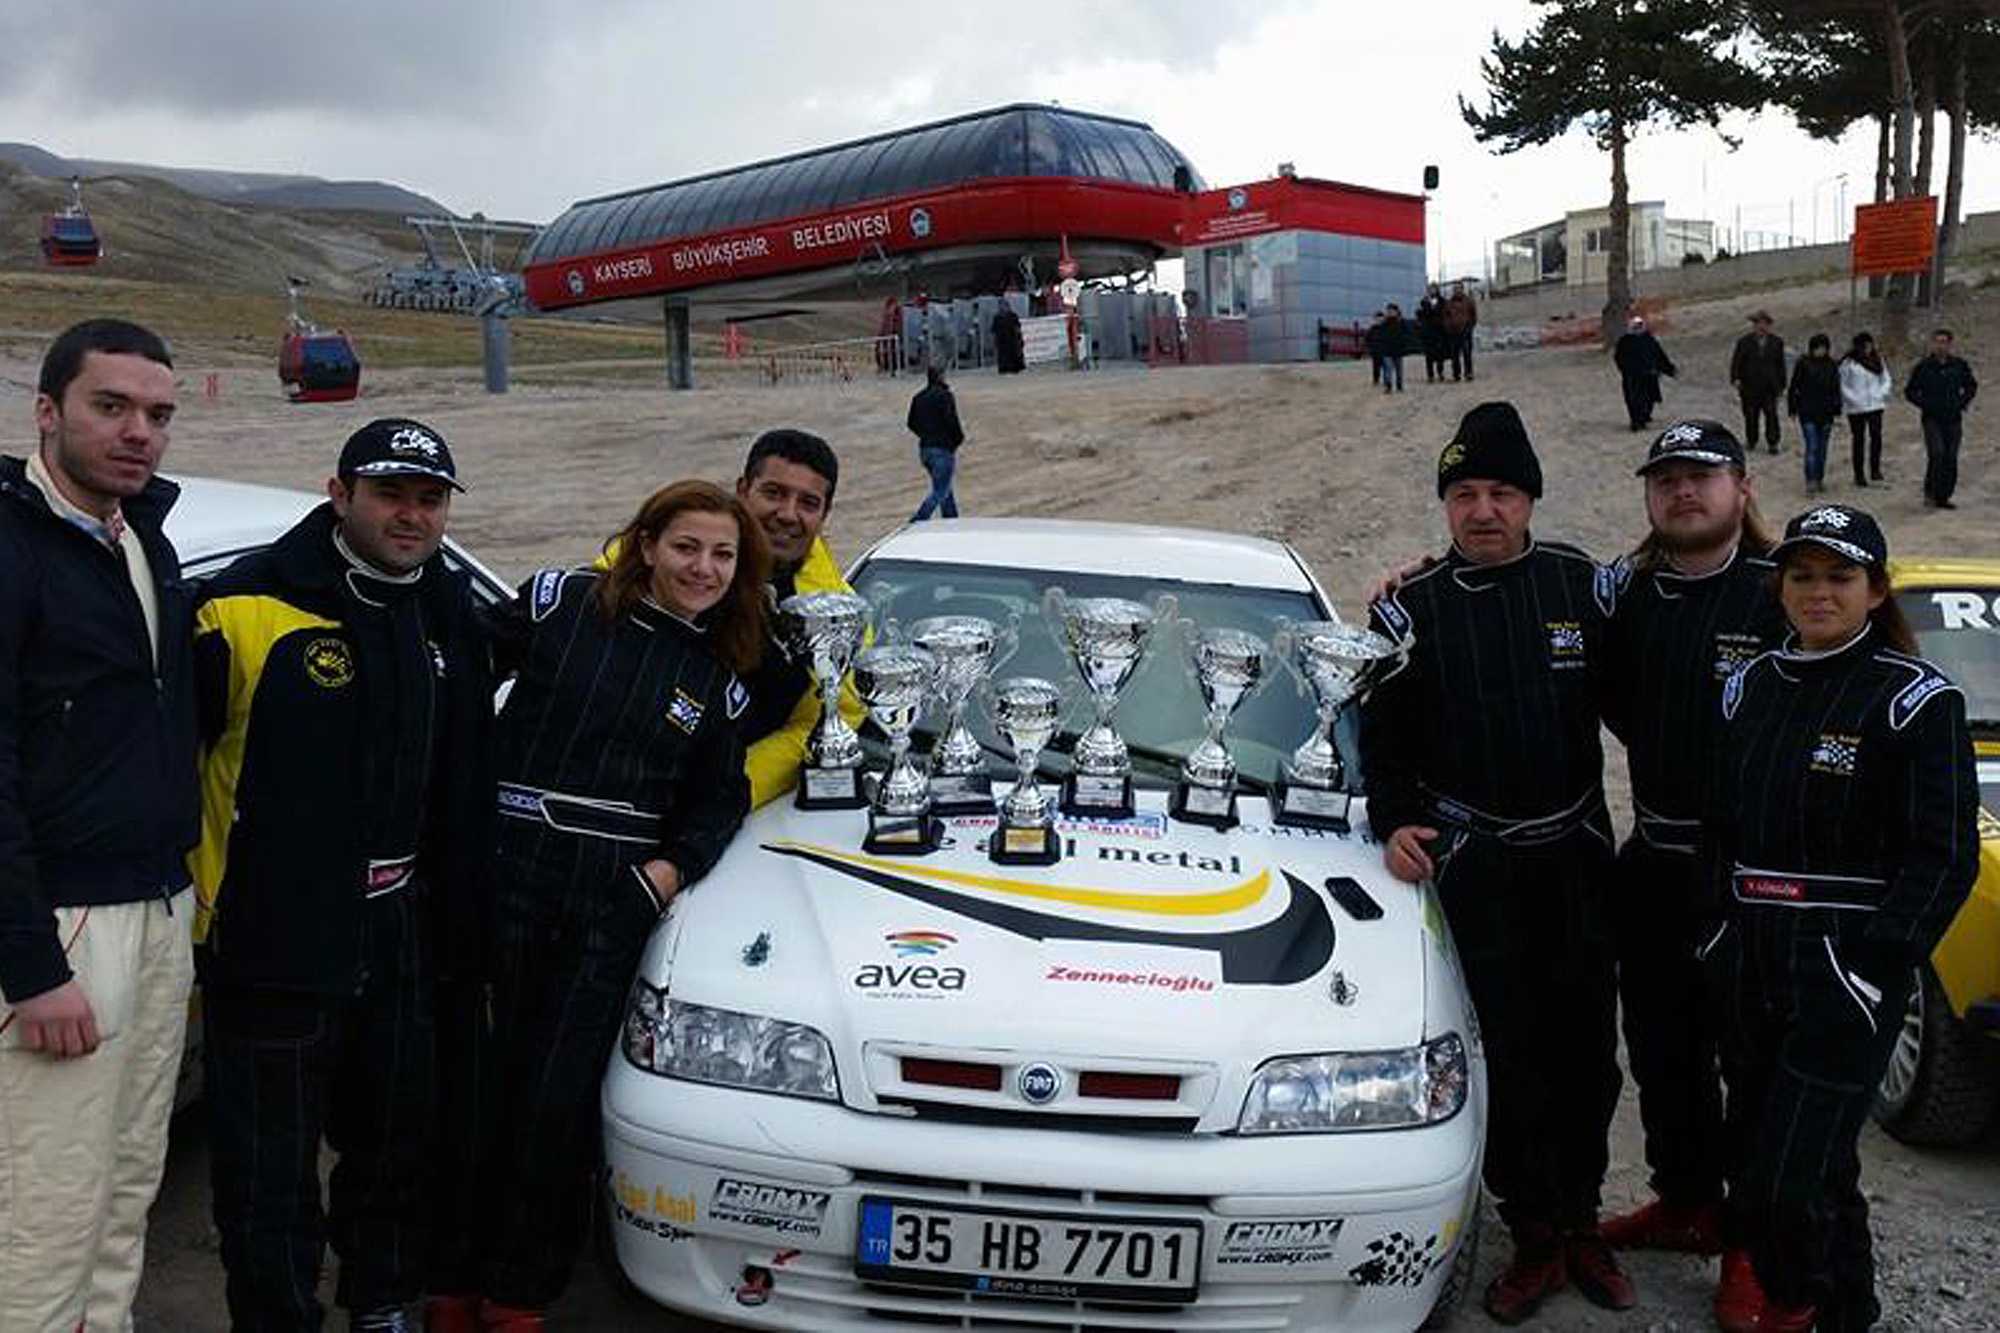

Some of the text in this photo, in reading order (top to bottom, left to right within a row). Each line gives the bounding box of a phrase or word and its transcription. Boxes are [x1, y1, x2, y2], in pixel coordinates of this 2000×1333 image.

[594, 254, 652, 282] KAYSERİ
[793, 208, 891, 250] BELEDİYESİ
[1098, 846, 1241, 874] metal
[854, 964, 966, 990] avea
[1046, 966, 1214, 992] Zennecioğlu
[868, 1240, 888, 1254] TR
[894, 1214, 1181, 1280] 35 HB 7701
[1227, 1221, 1341, 1247] CROMX
